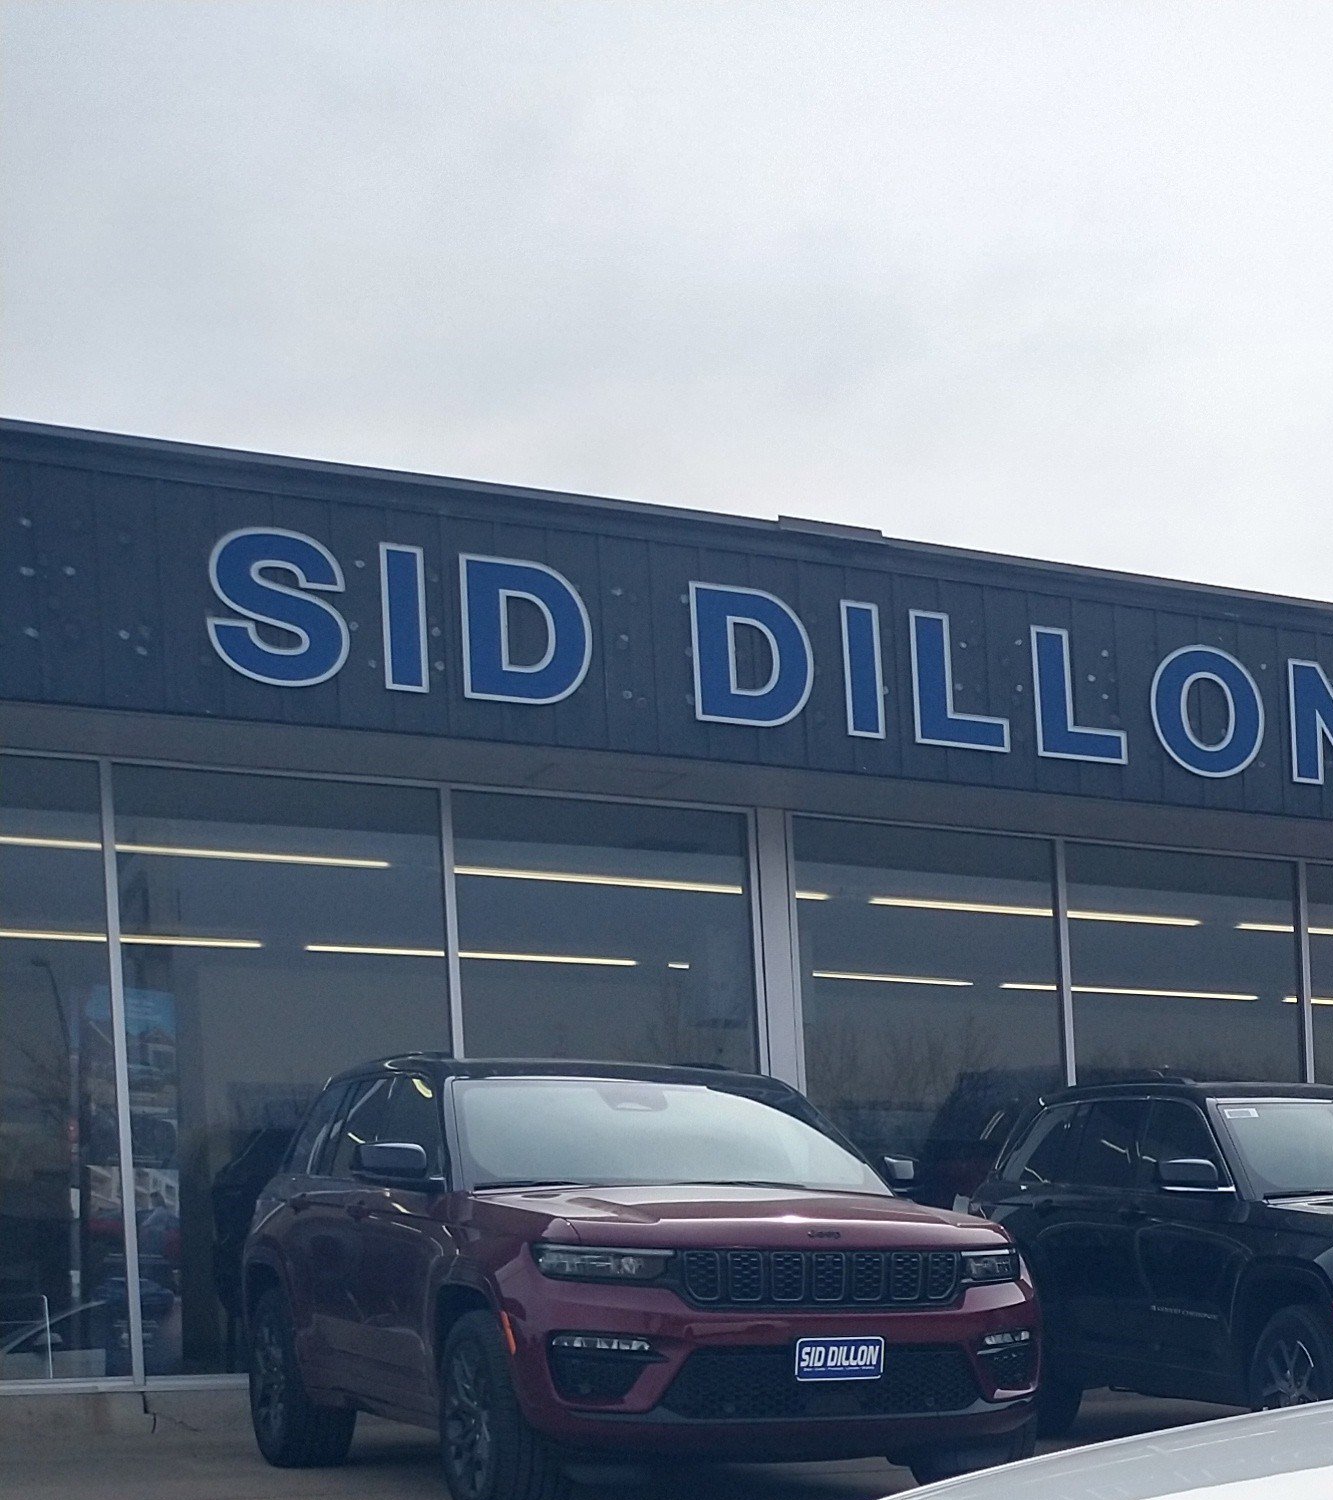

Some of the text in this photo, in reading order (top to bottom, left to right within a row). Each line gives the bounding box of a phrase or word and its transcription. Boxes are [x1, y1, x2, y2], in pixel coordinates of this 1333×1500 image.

[206, 526, 593, 705] SID
[800, 1345, 880, 1368] SID DILLON
